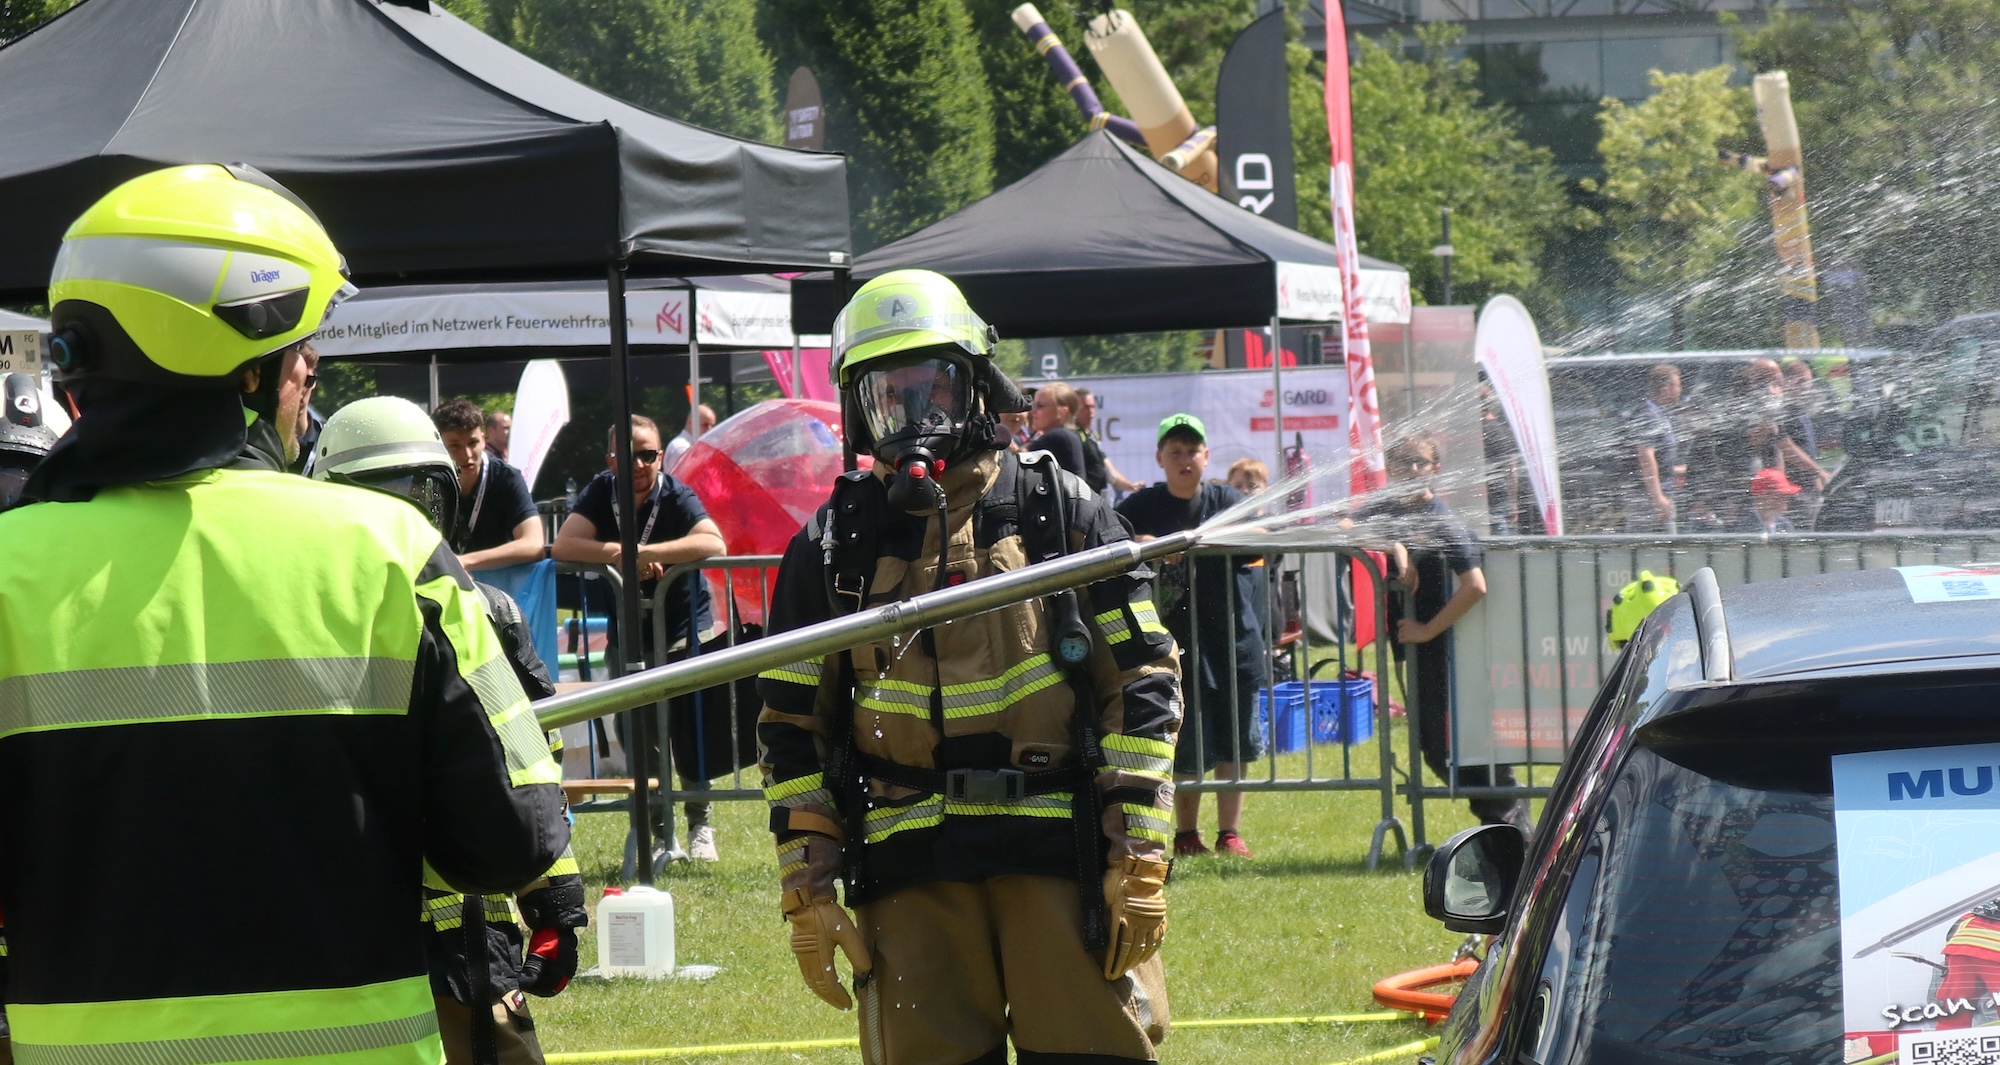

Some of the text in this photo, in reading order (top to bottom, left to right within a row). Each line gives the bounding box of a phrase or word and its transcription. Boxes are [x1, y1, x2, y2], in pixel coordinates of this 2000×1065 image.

[250, 270, 280, 283] Dräger
[891, 299, 907, 317] A
[313, 315, 634, 341] erde Mitglied im Netzwerk Feuerwehrfran
[1888, 766, 2000, 801] MU
